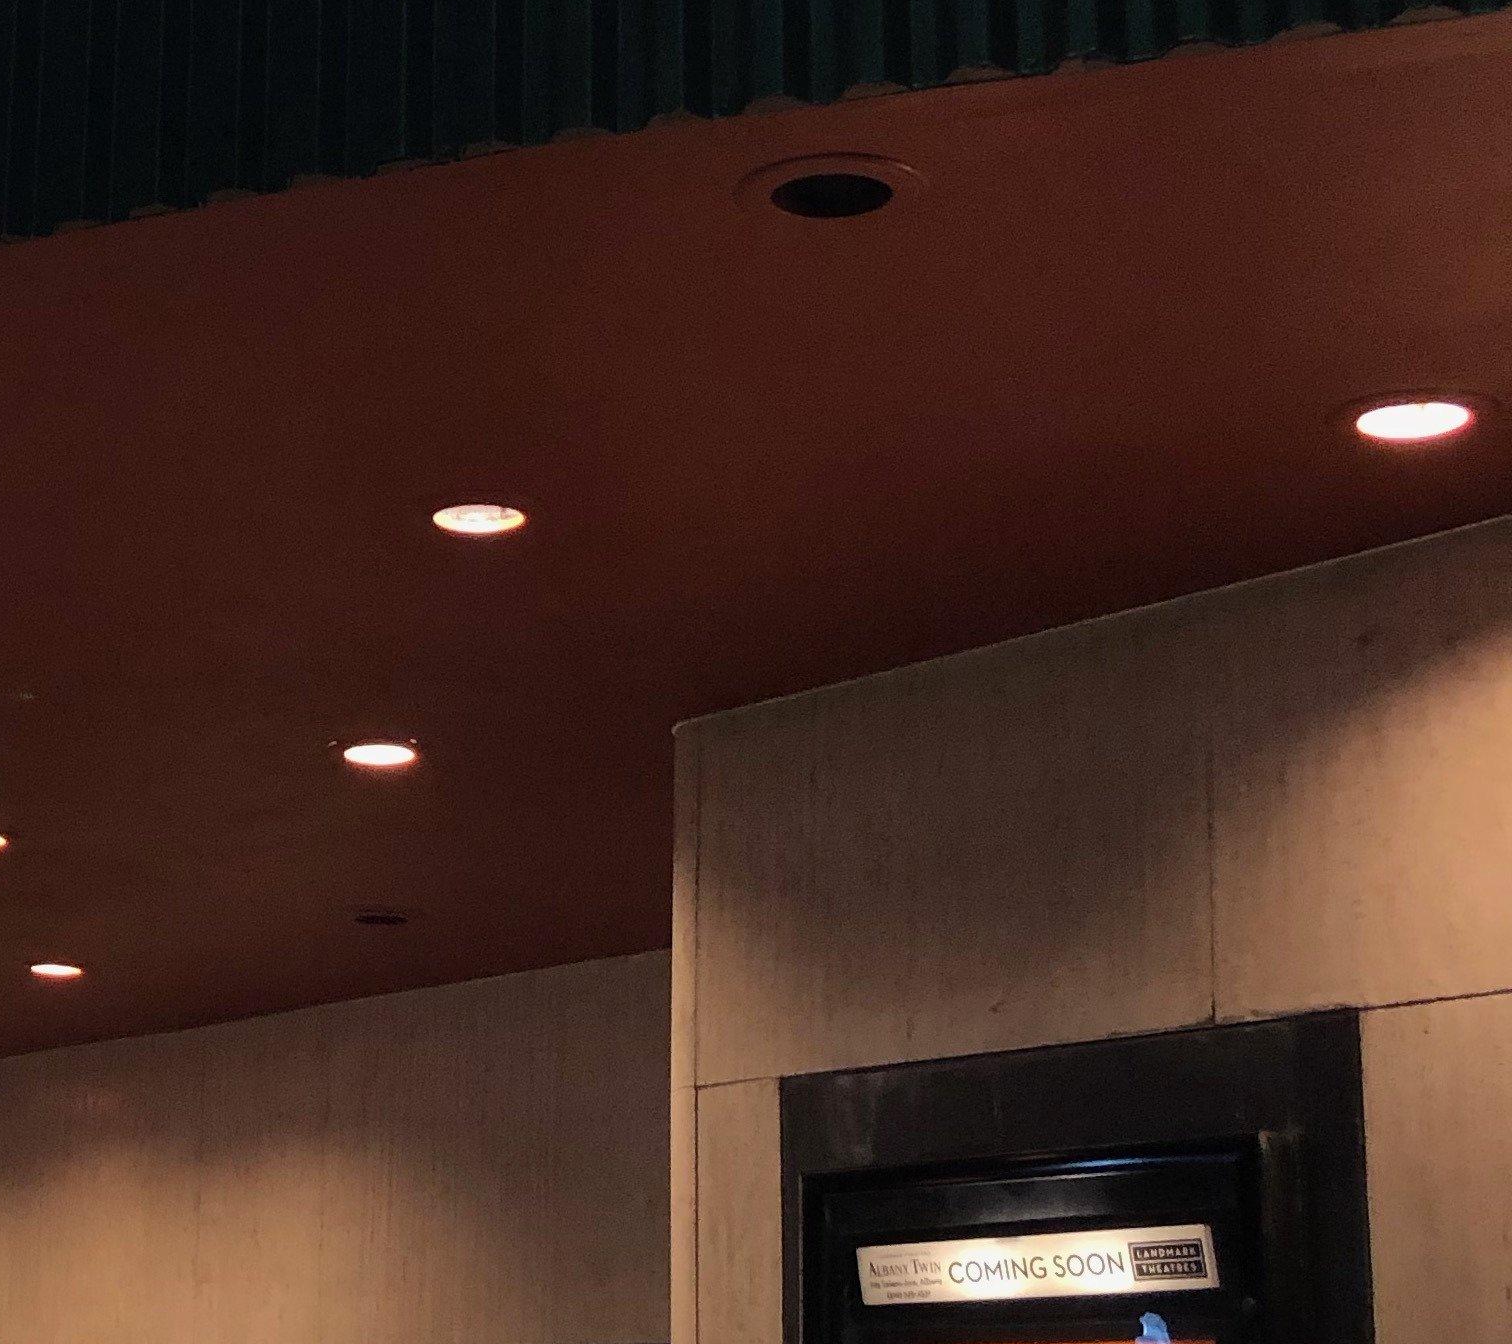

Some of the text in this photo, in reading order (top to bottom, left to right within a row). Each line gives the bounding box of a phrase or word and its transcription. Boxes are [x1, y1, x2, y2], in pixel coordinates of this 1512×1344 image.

[1136, 1244, 1197, 1259] LANDMARK
[949, 1252, 1125, 1283] COMING SOON
[1141, 1262, 1199, 1275] THEATRES
